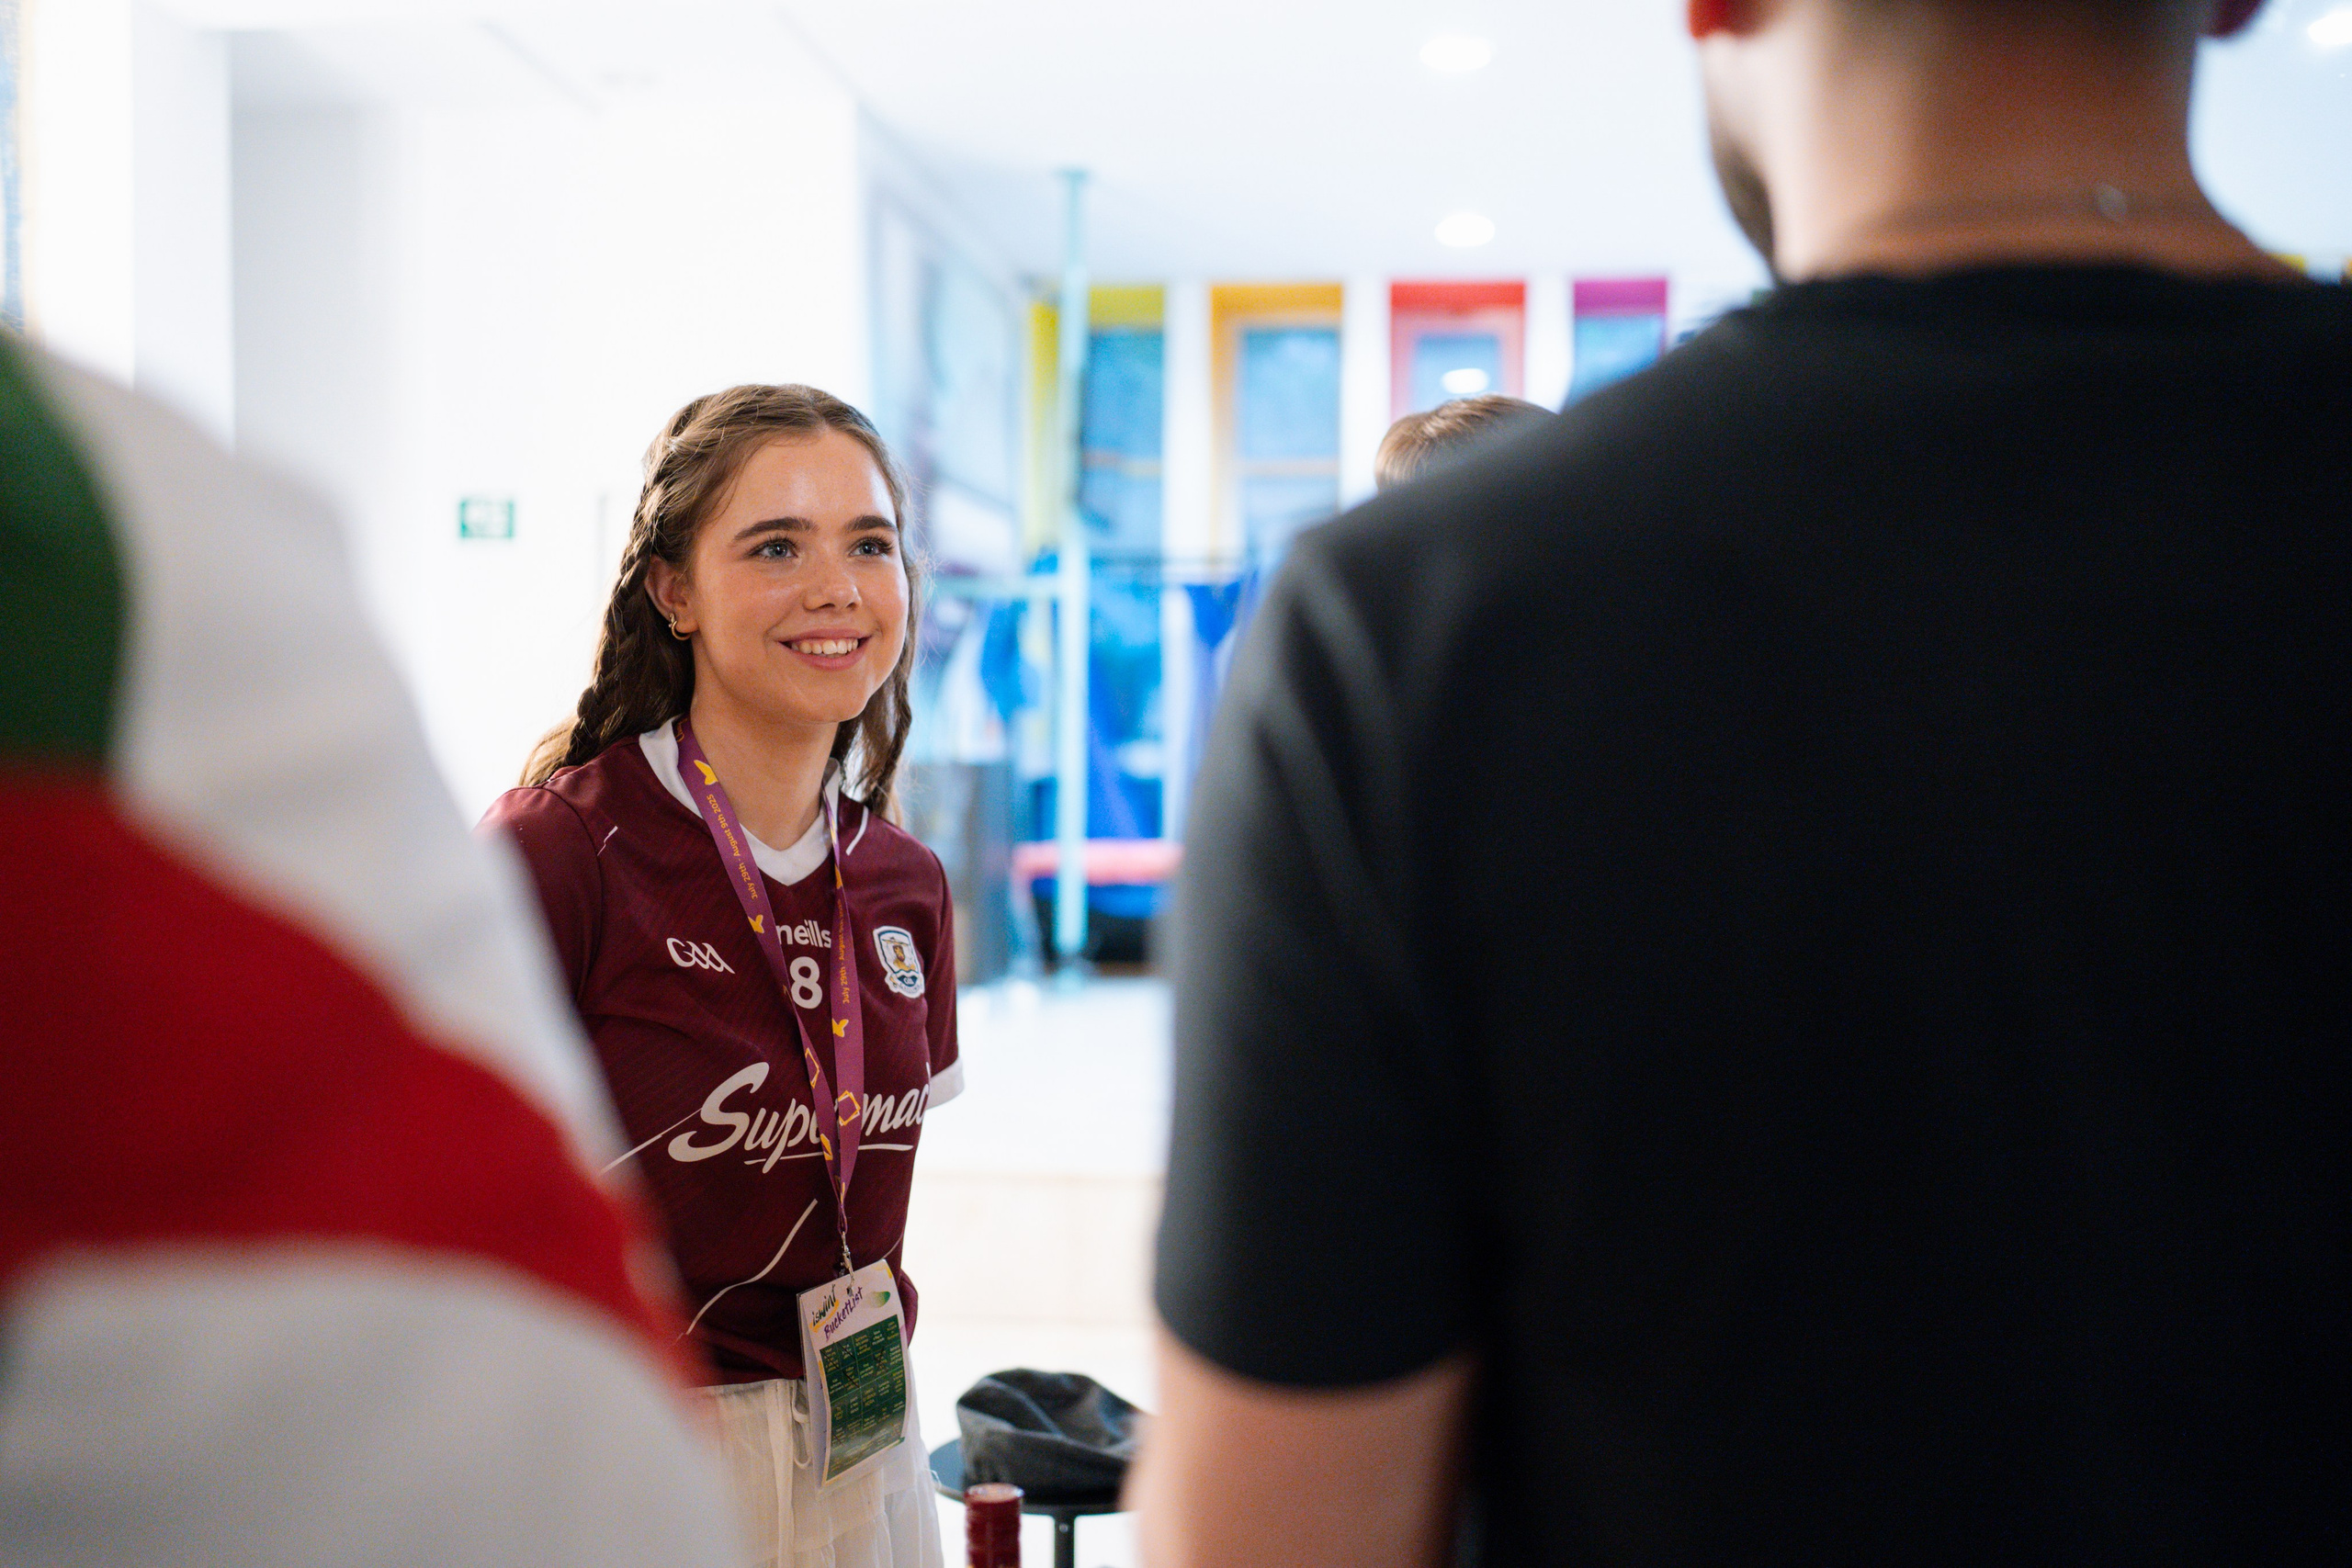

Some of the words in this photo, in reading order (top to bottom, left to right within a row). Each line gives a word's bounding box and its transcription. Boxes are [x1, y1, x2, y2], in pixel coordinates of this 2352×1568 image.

[706, 794, 721, 814] 2025
[717, 813, 729, 829] 9th
[723, 828, 741, 857] August
[738, 862, 752, 883] 29th
[747, 882, 759, 900] July
[789, 955, 823, 1010] 8
[840, 965, 848, 987] 29th
[842, 987, 851, 1005] July
